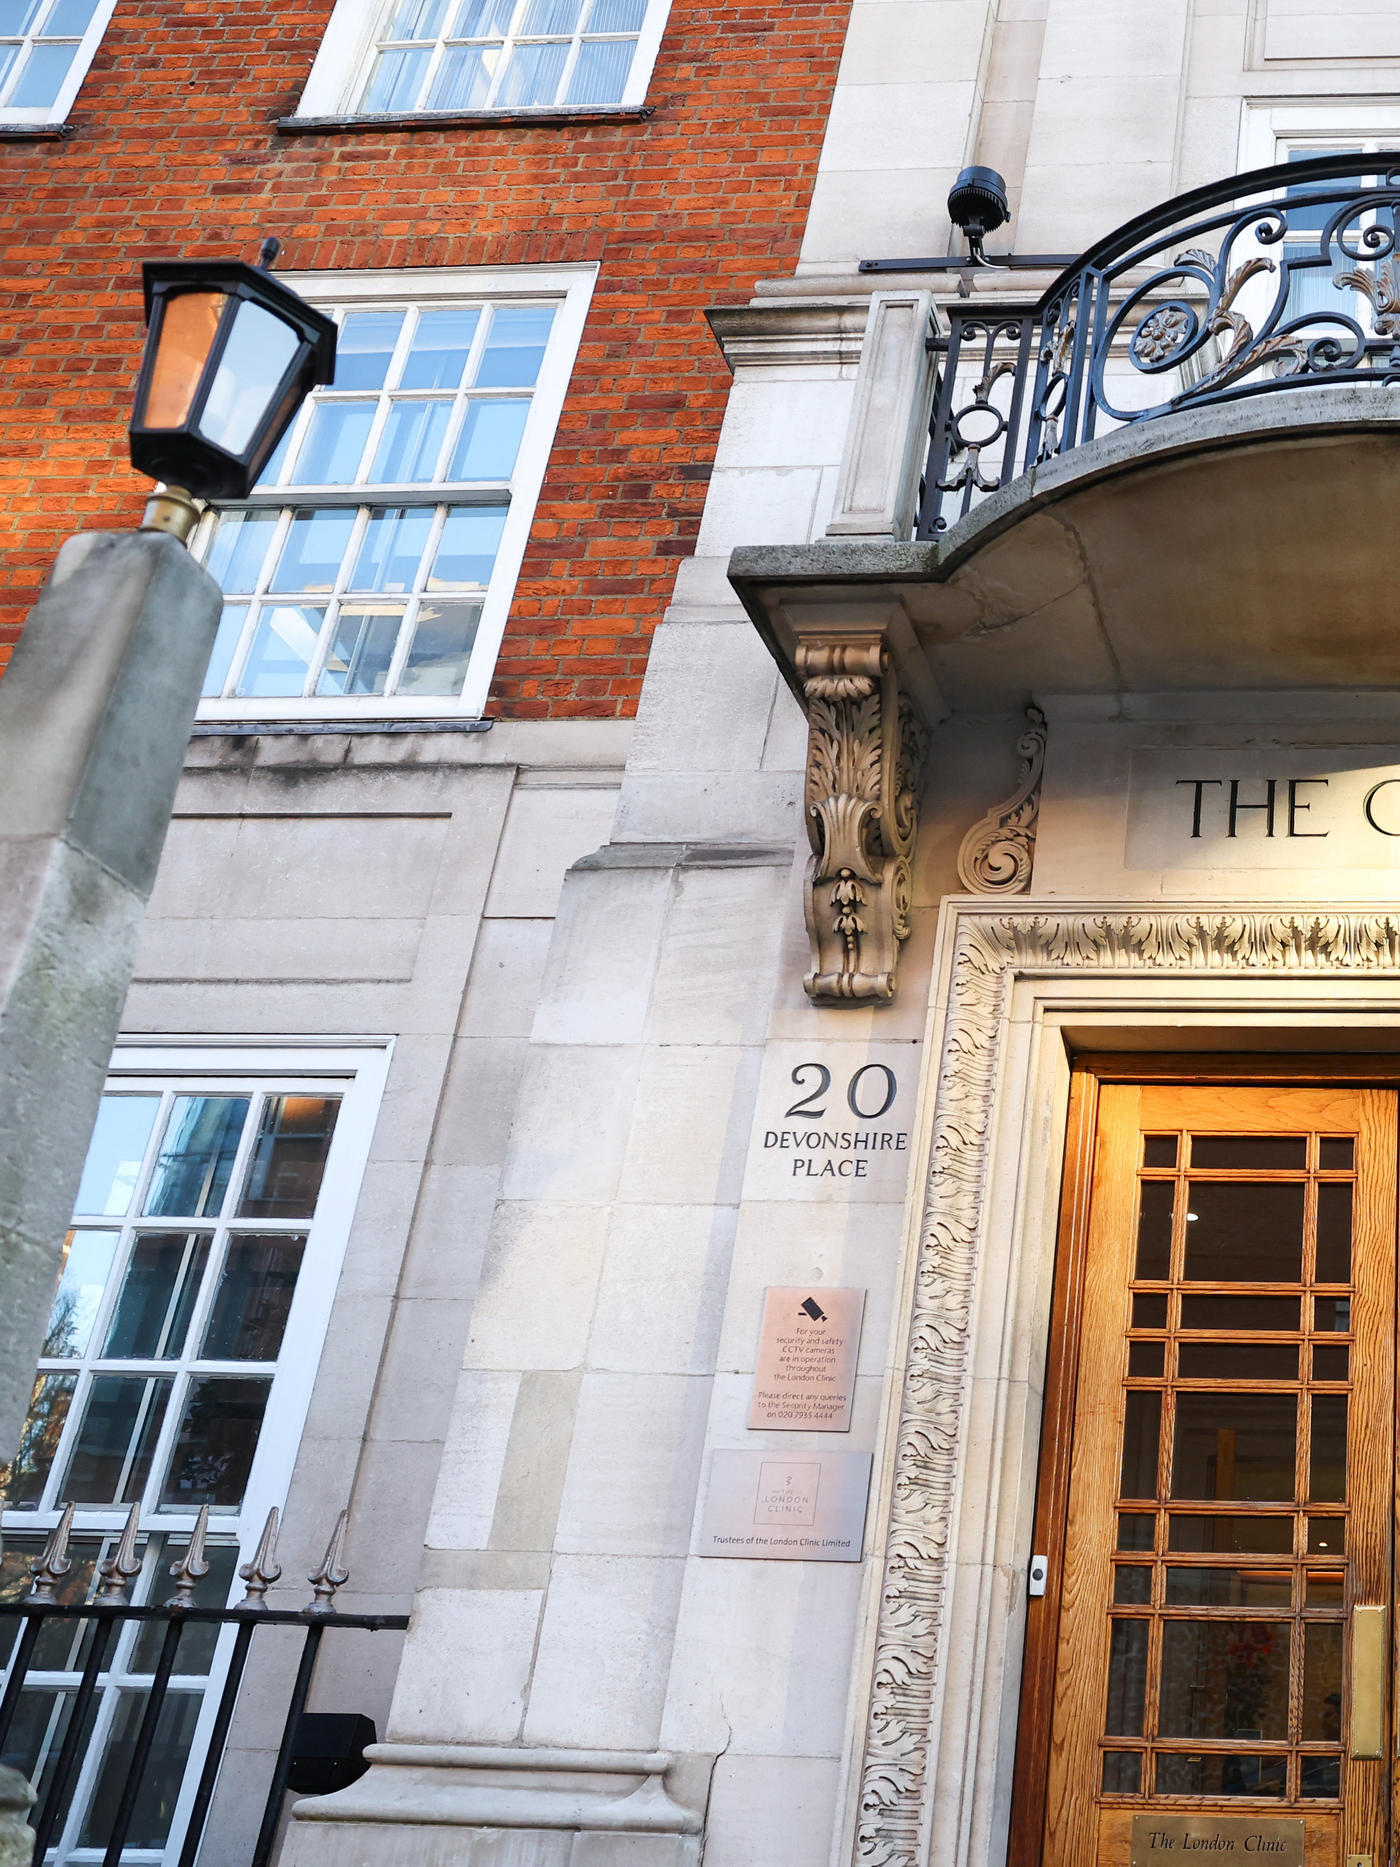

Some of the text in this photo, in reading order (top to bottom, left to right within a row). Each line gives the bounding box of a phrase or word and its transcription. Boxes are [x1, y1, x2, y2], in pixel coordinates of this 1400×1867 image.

[1176, 779, 1329, 838] THE
[785, 1063, 897, 1119] 20
[764, 1132, 907, 1150] DEVONSHIRE
[792, 1159, 868, 1177] PLACE
[777, 1337, 805, 1345] security
[821, 1338, 843, 1346] safety
[801, 1356, 836, 1364] operation
[786, 1365, 826, 1373] throughout
[782, 1392, 803, 1400] direct
[782, 1402, 811, 1411] Security
[813, 1403, 844, 1412] Manager
[768, 1505, 803, 1513] CLINIC
[713, 1536, 744, 1545] Trustees
[756, 1537, 768, 1545] the
[770, 1538, 798, 1546] London
[822, 1539, 851, 1547] Limited
[1149, 1832, 1286, 1852] The London Clinic
